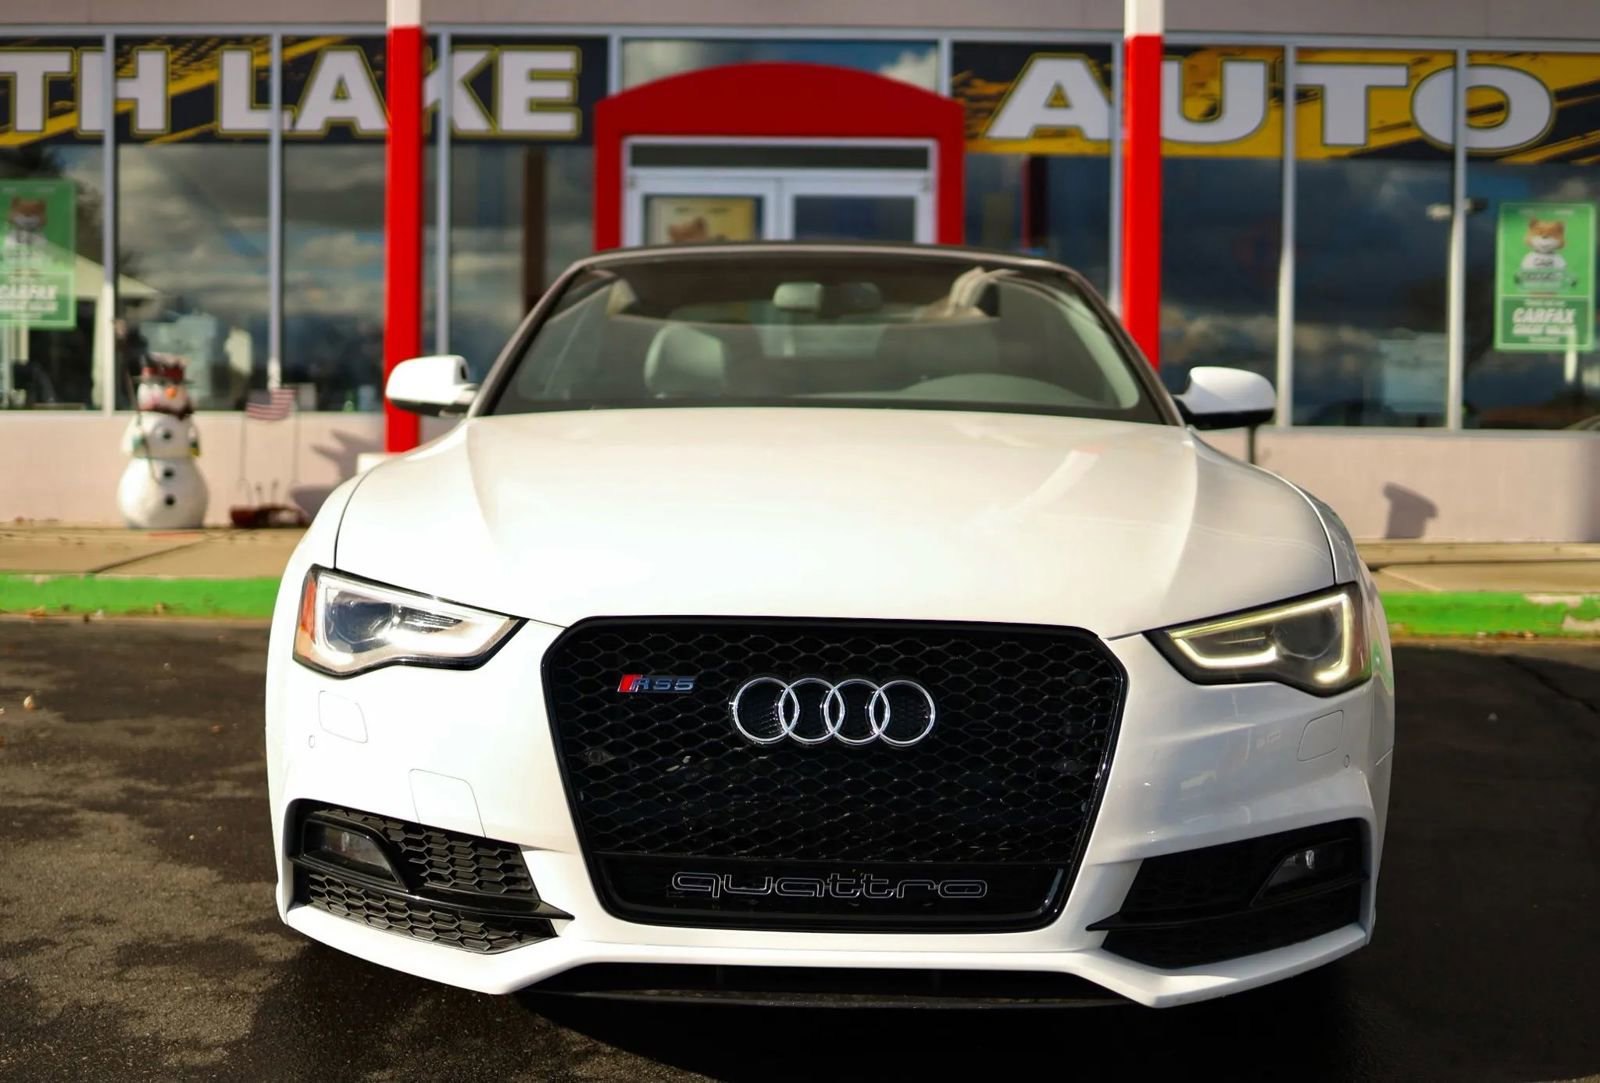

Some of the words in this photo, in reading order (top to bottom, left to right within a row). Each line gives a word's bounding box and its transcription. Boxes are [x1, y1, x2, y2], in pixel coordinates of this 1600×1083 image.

[219, 48, 580, 136] LAKE
[984, 52, 1554, 152] AUTO
[1512, 307, 1576, 324] CARFAX
[630, 675, 696, 691] RS5
[671, 871, 988, 899] quattro
